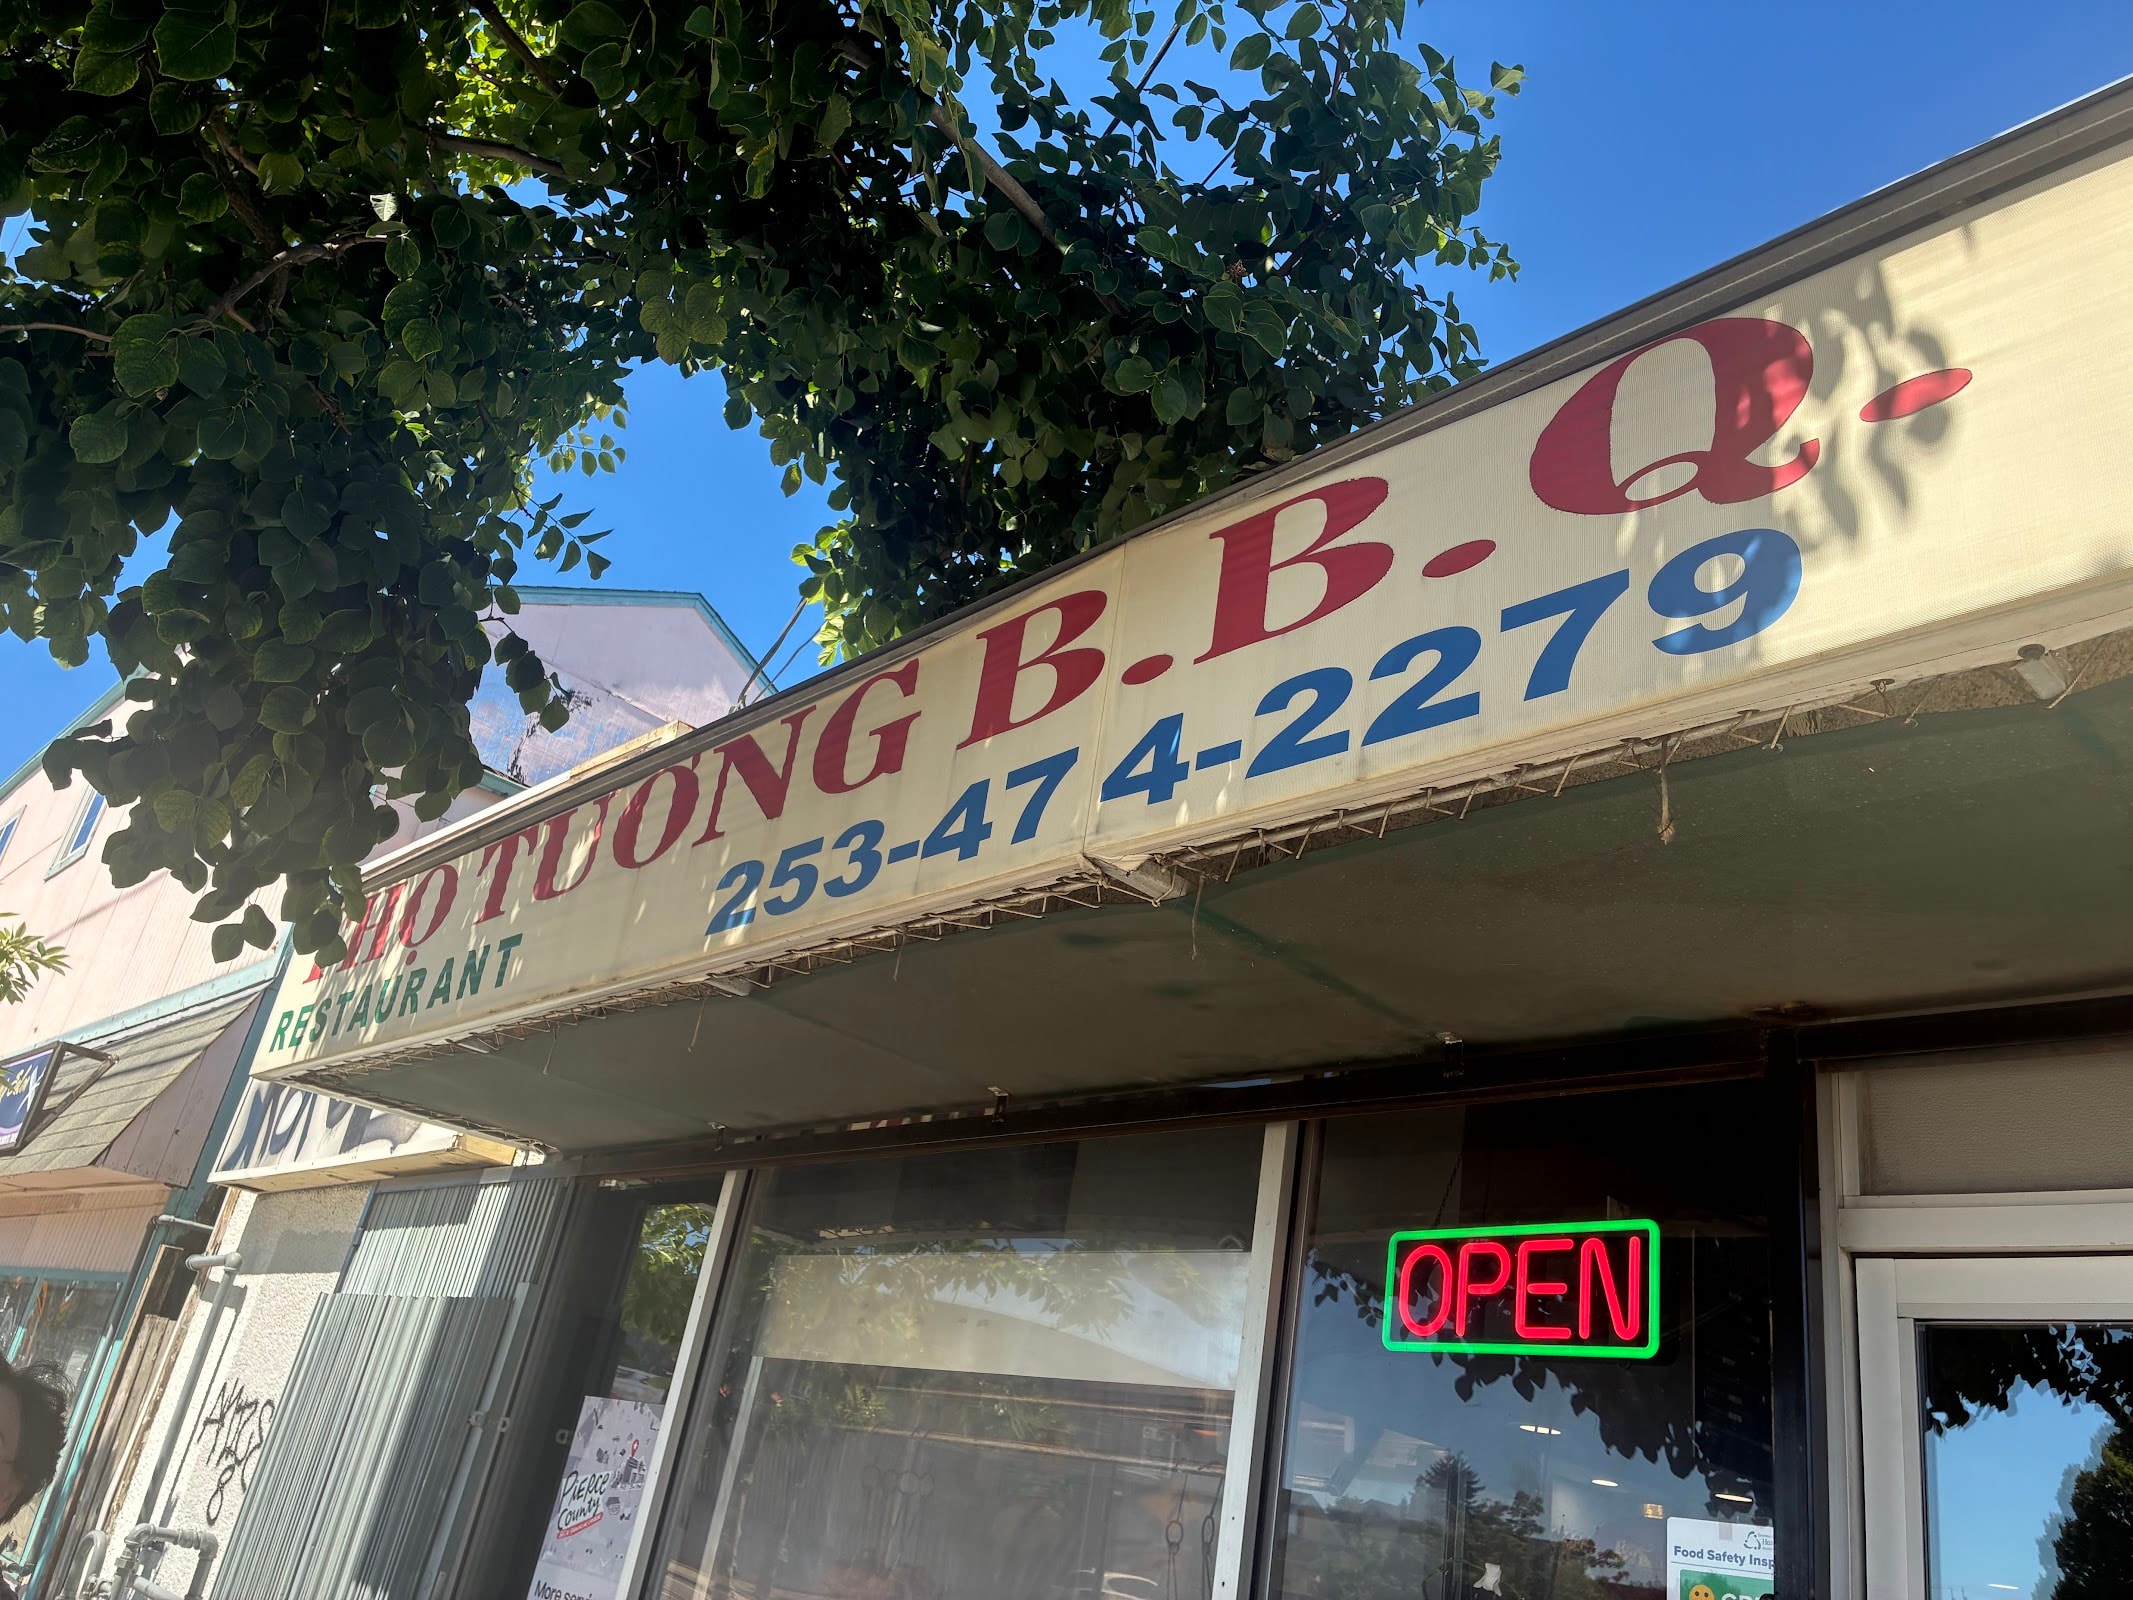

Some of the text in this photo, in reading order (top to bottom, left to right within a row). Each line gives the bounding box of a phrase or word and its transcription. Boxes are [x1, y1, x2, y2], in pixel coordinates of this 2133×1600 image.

[705, 528, 1803, 936] 253-474-2279
[269, 933, 523, 1054] RESTAURANT
[1398, 1235, 1641, 1341] OPEN
[534, 1580, 562, 1600] More
[1673, 1545, 1704, 1559] Food
[1707, 1549, 1746, 1567] Safety
